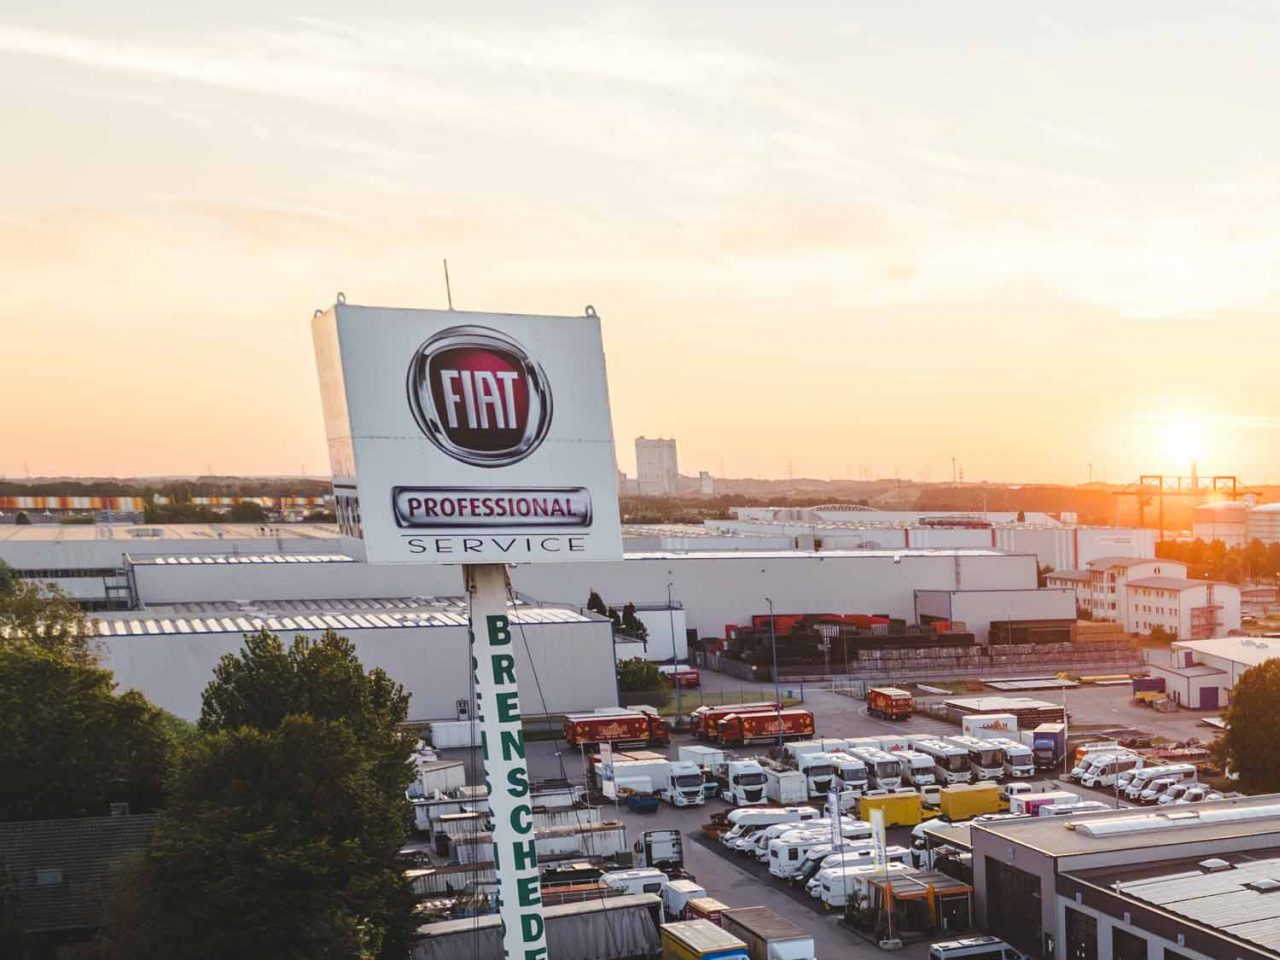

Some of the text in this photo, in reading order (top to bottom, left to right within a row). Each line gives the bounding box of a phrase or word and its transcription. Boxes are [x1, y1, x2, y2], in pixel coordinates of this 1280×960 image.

[440, 369, 518, 430] FIAT
[407, 497, 577, 518] PROFESSIONAL
[408, 536, 586, 554] SERVICE
